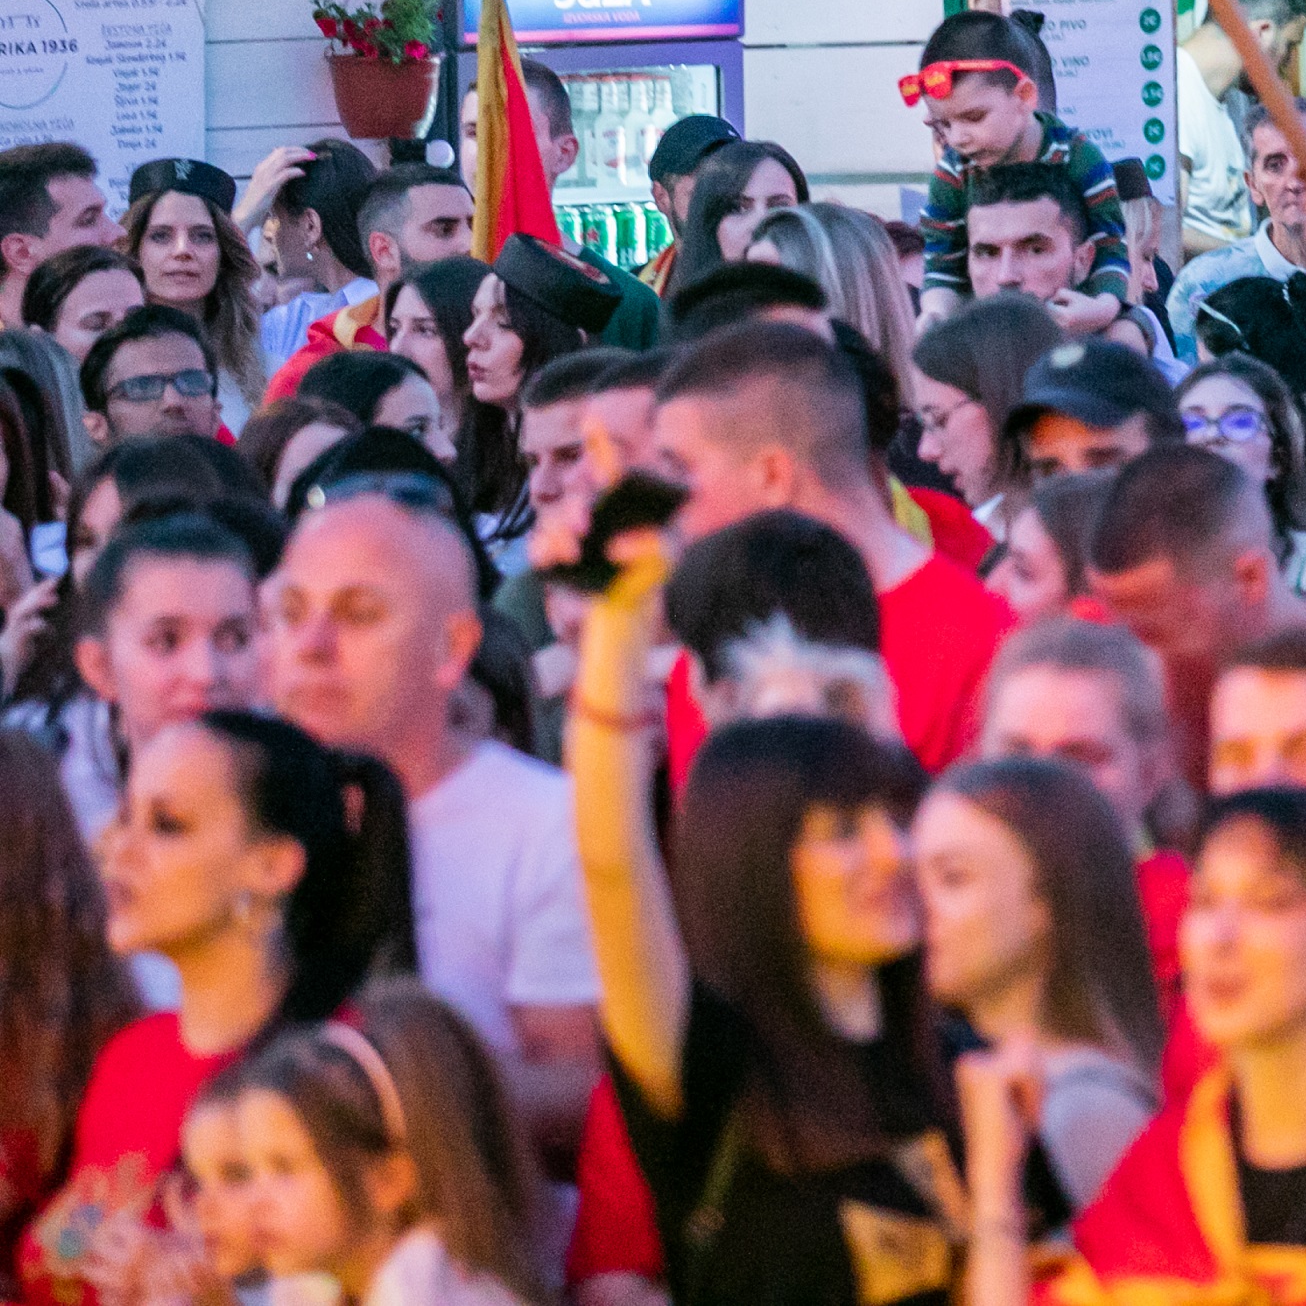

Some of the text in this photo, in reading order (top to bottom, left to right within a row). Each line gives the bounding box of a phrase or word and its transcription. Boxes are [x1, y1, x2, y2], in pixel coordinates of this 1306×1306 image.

[1059, 19, 1087, 31] PIVO
[41, 38, 79, 53] 1936
[1060, 56, 1090, 68] VINO
